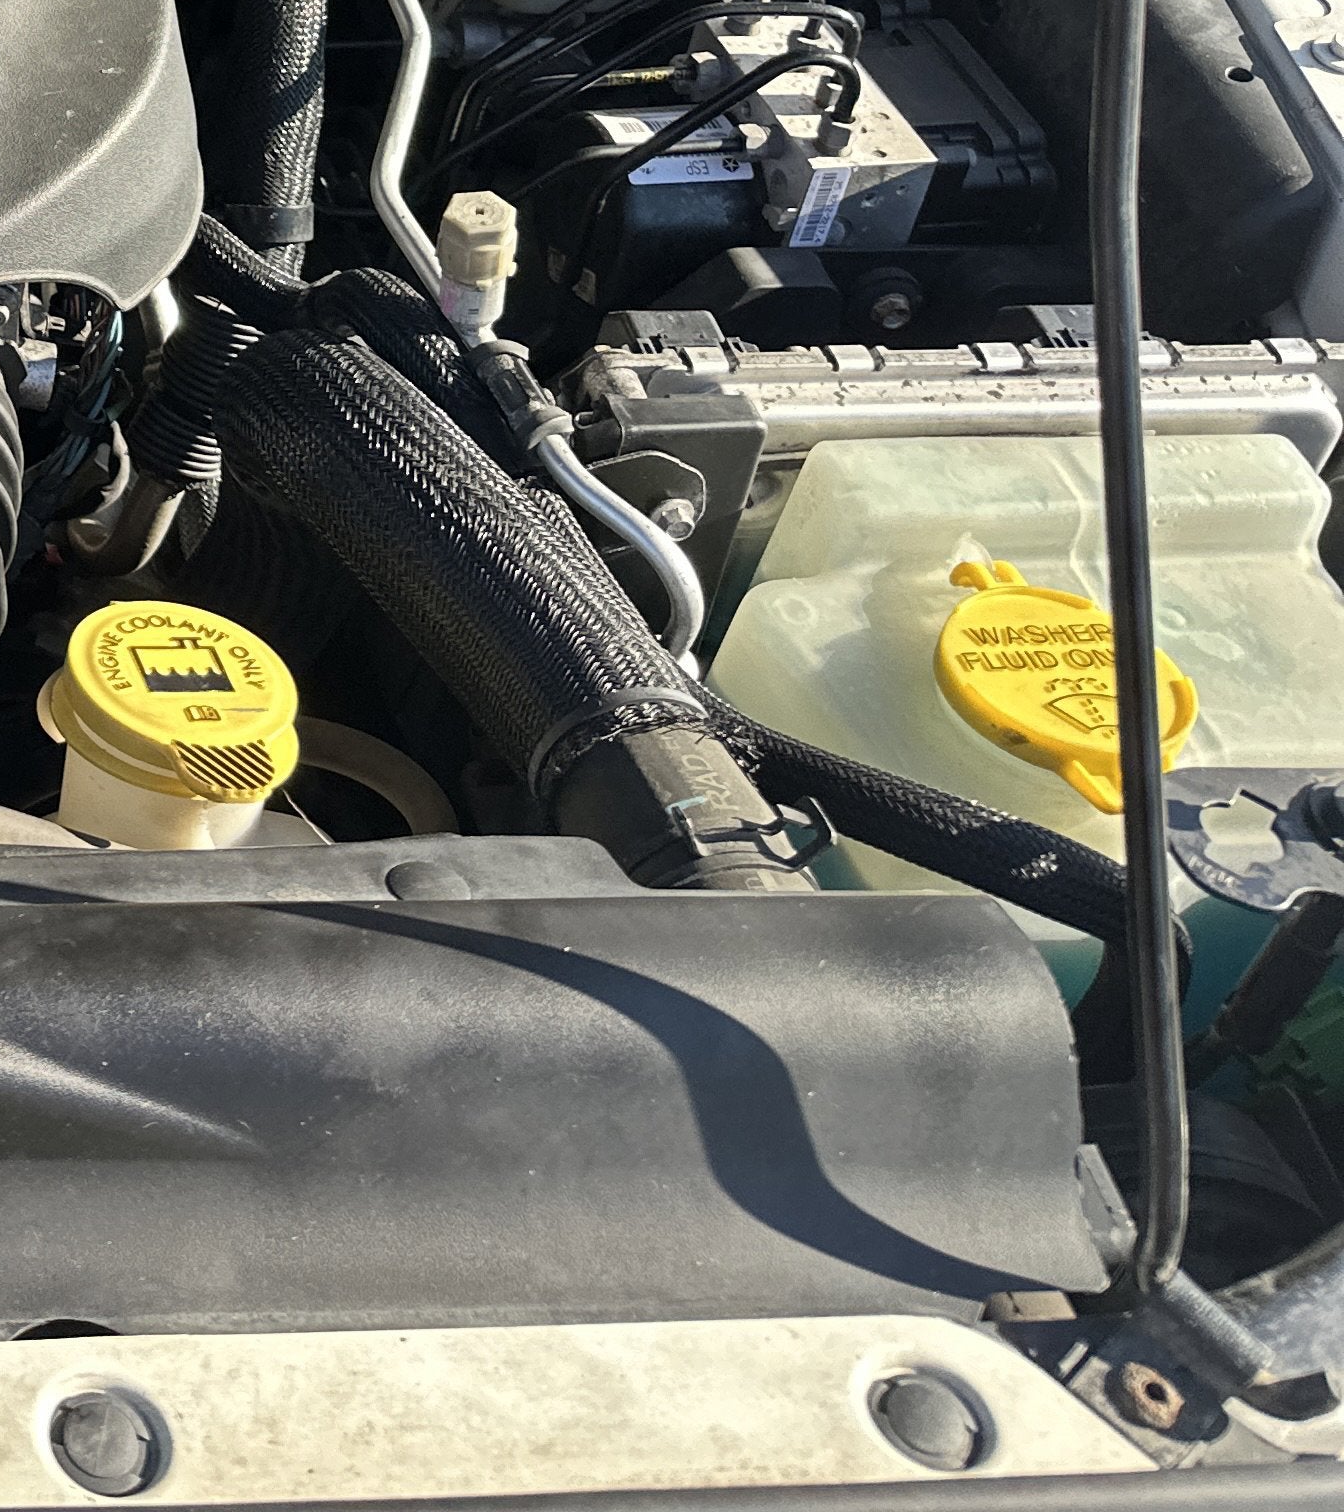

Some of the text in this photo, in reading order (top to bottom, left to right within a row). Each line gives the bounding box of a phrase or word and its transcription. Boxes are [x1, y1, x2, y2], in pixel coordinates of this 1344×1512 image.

[685, 159, 710, 176] ESP
[962, 623, 1115, 646] WASHER
[98, 614, 267, 693] ENGINE COOLANT ONLY
[956, 649, 1059, 672] FLUID
